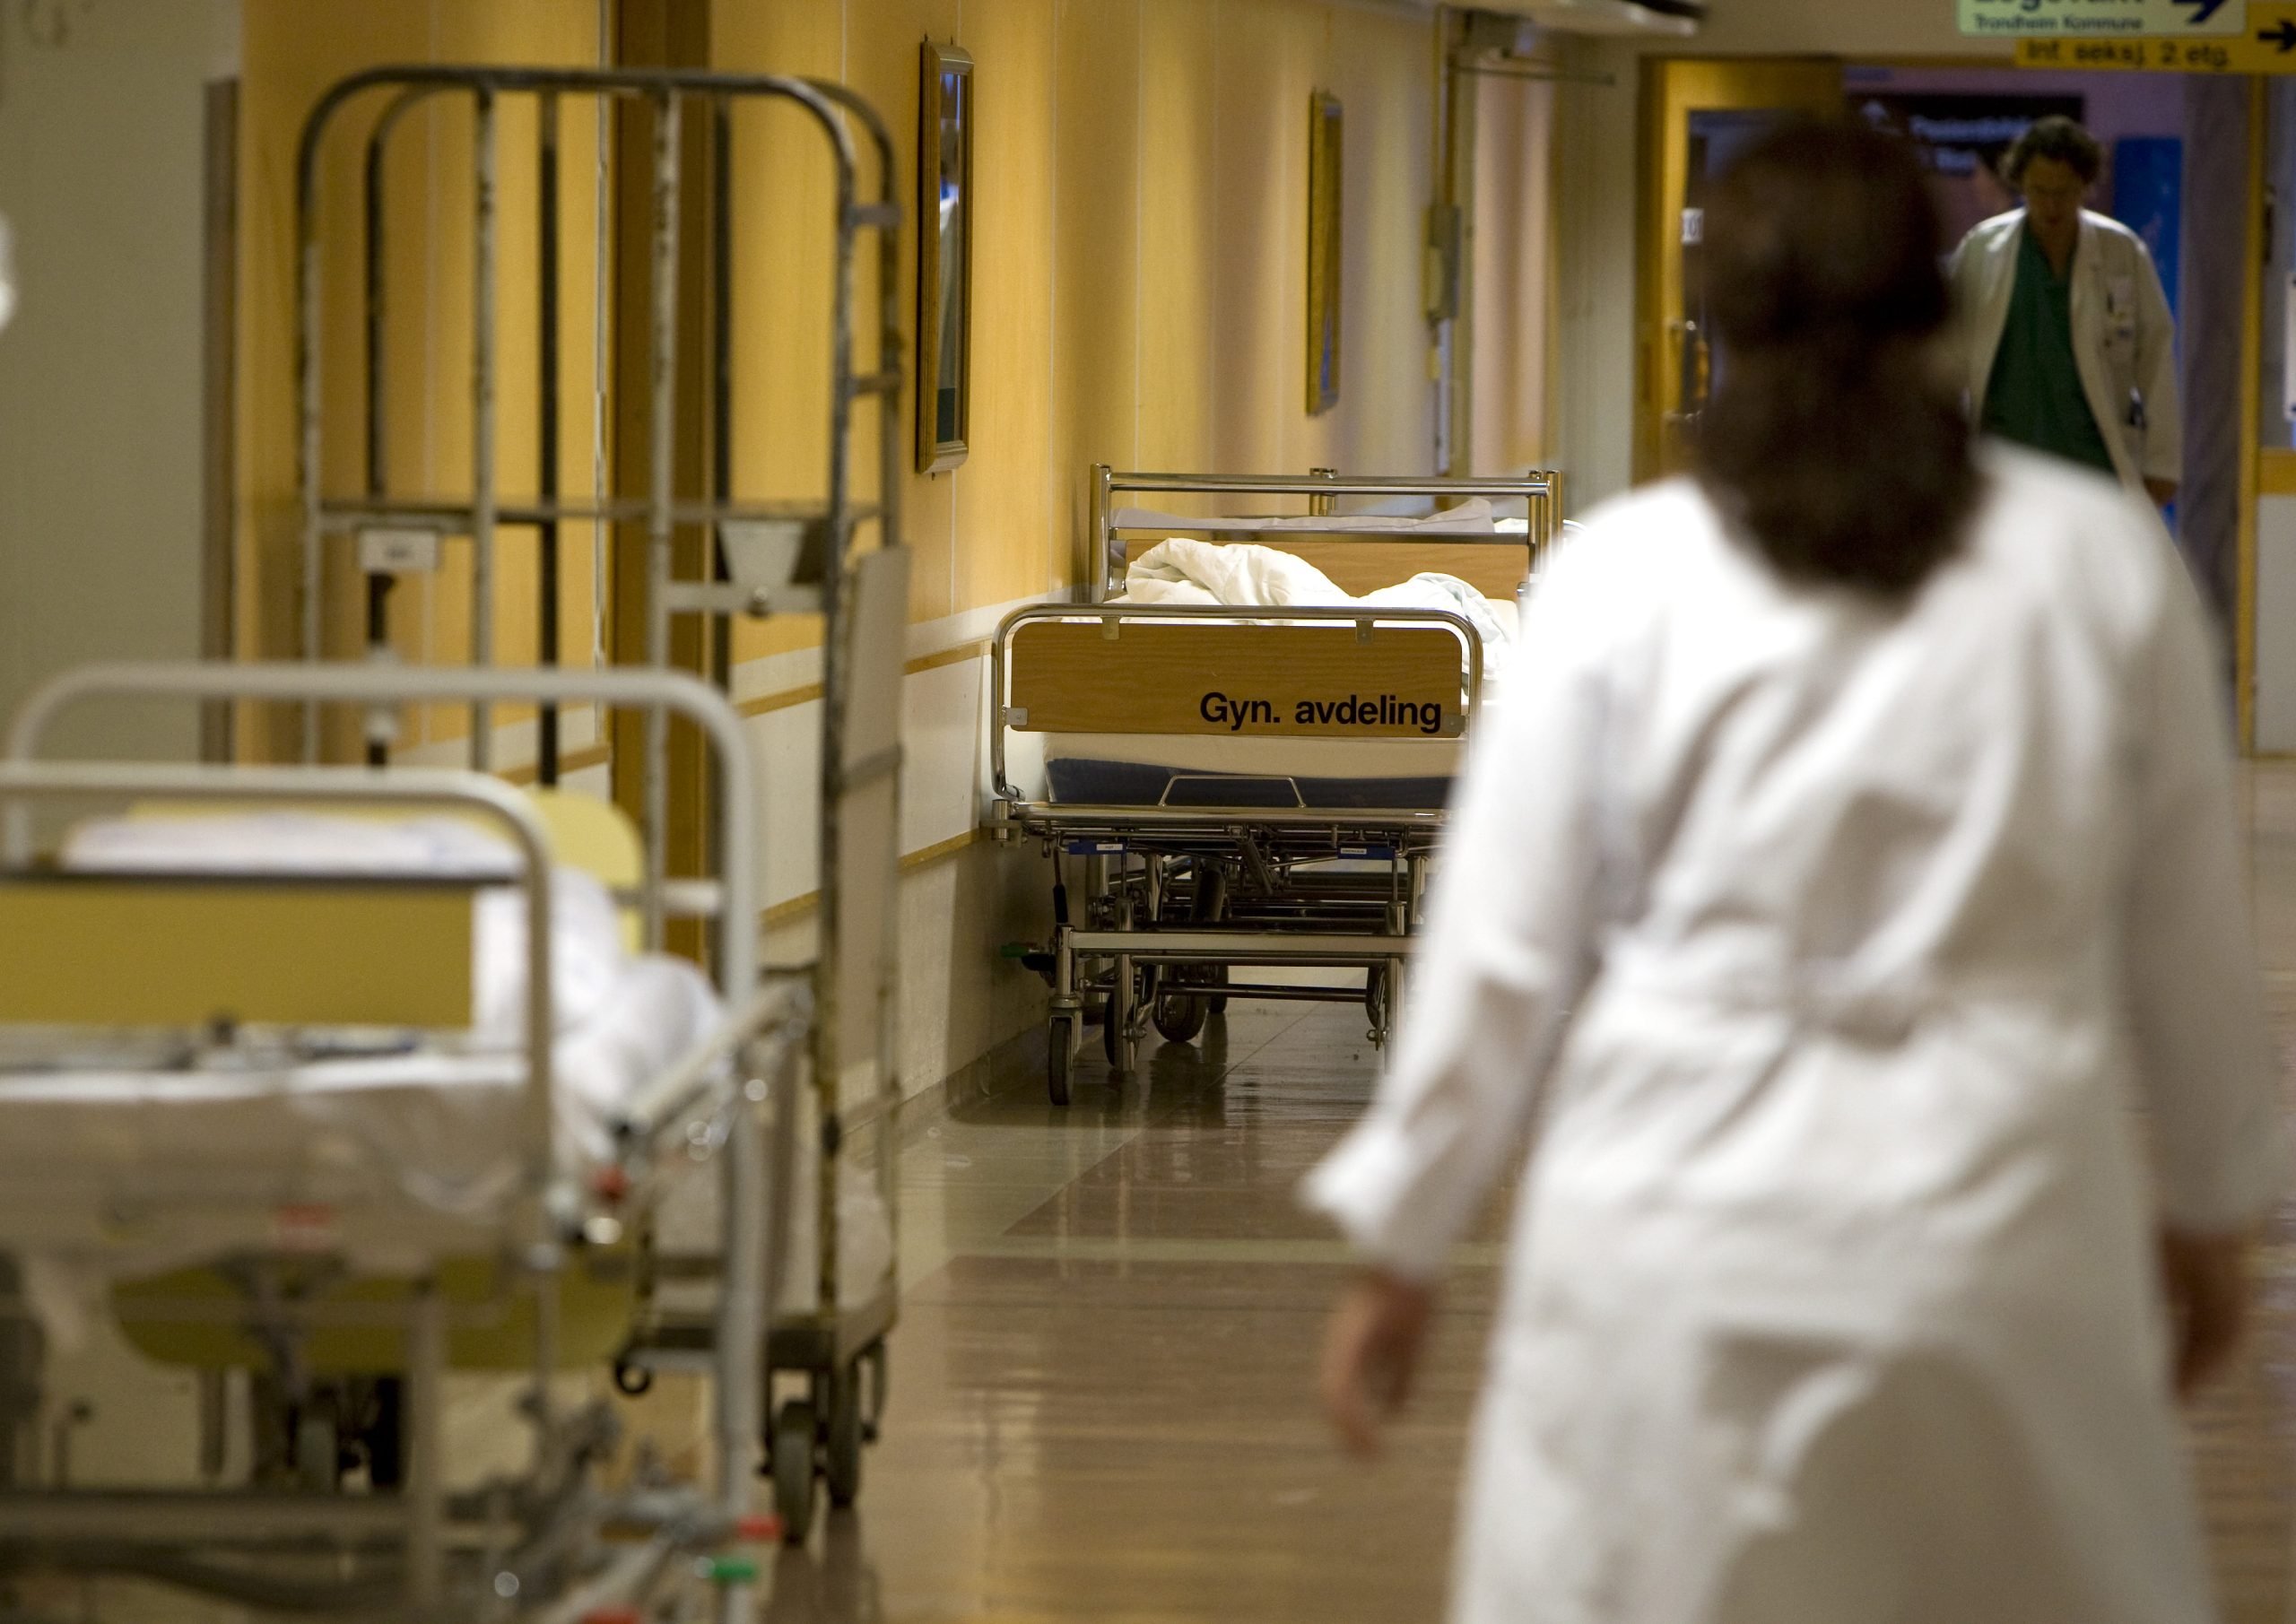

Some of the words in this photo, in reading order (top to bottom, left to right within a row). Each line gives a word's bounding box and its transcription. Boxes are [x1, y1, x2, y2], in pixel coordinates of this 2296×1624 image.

[1976, 14, 2057, 30] Trondheim
[1200, 691, 1281, 731] Gyn.
[1294, 694, 1441, 734] avdeling
